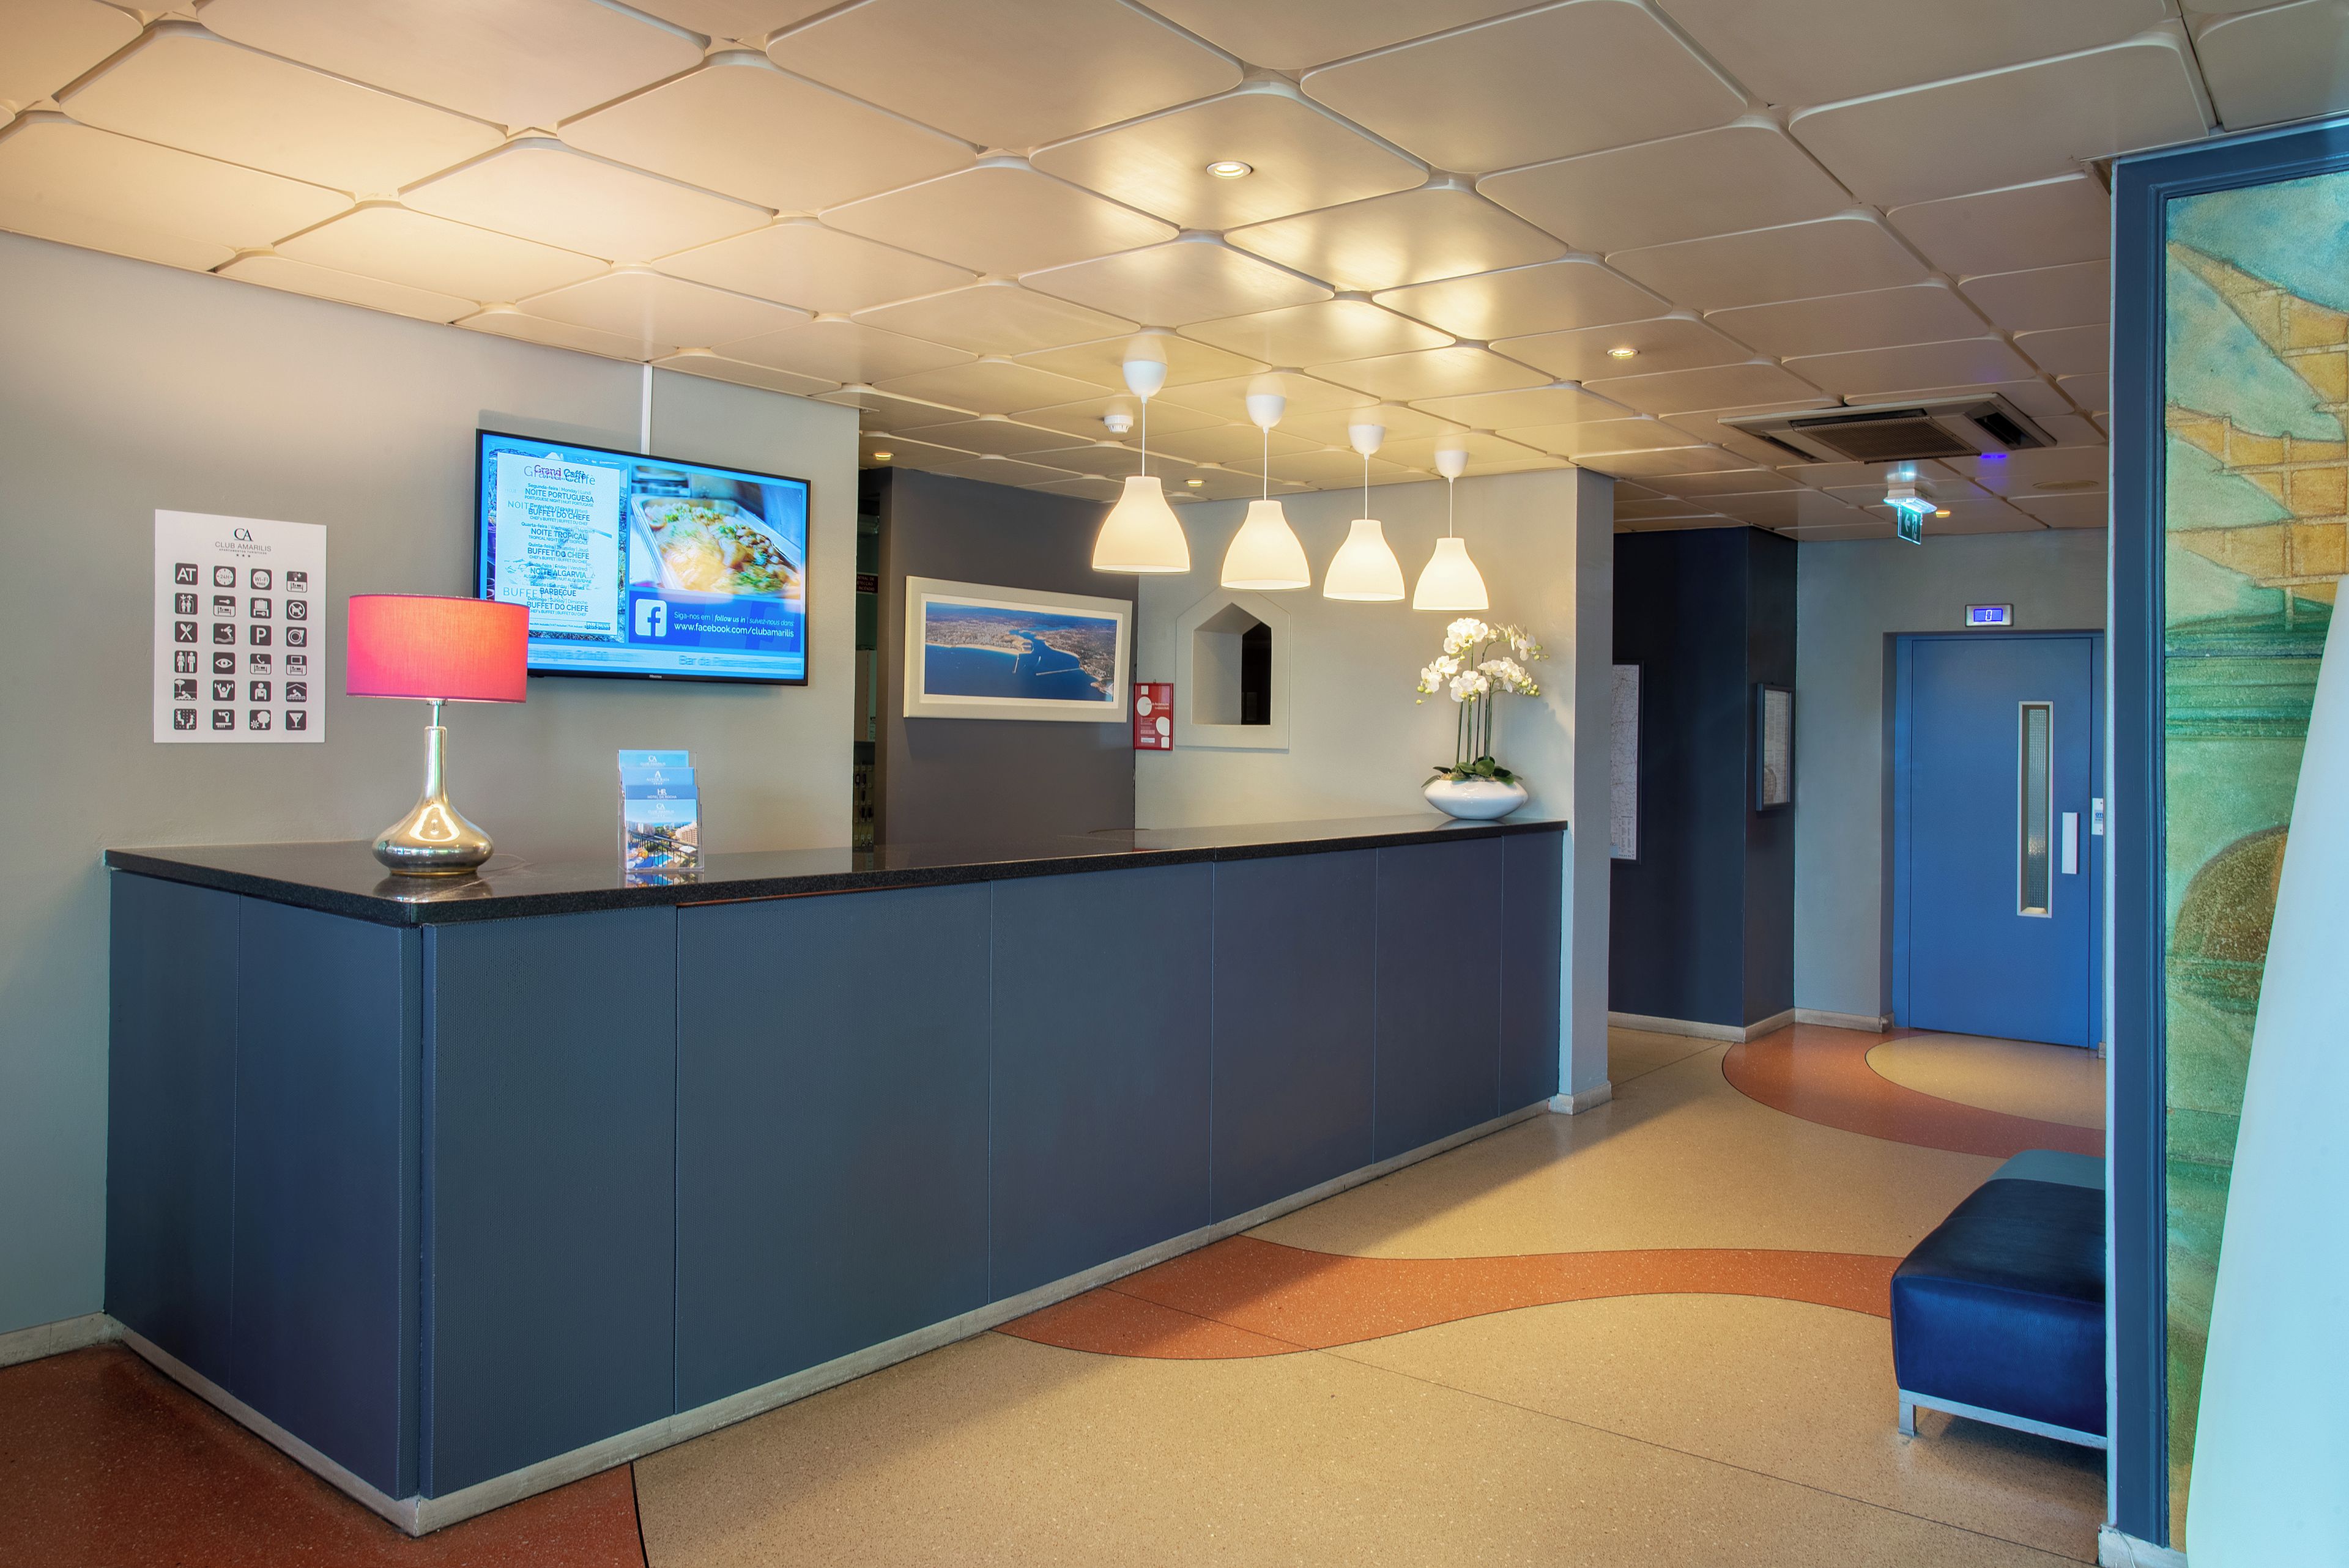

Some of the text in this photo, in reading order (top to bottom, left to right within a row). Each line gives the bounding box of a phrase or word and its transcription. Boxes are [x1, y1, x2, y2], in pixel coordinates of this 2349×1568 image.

[525, 488, 595, 503] NOITE PORTUGUESA
[529, 508, 554, 517] BUFFET
[234, 528, 253, 542] CA
[531, 528, 587, 541] NOITE TROPICAL
[527, 547, 554, 557] BUFFET
[568, 551, 590, 560] CHEFE
[176, 567, 197, 582] AT
[530, 568, 587, 579] NOITE ALGARVIA
[540, 588, 576, 597] BARBECUE
[674, 612, 700, 621] Siga-nos
[749, 616, 780, 626] suivez-nous
[256, 627, 267, 643] P
[674, 623, 794, 637] www.facebook.com/clubamarilis
